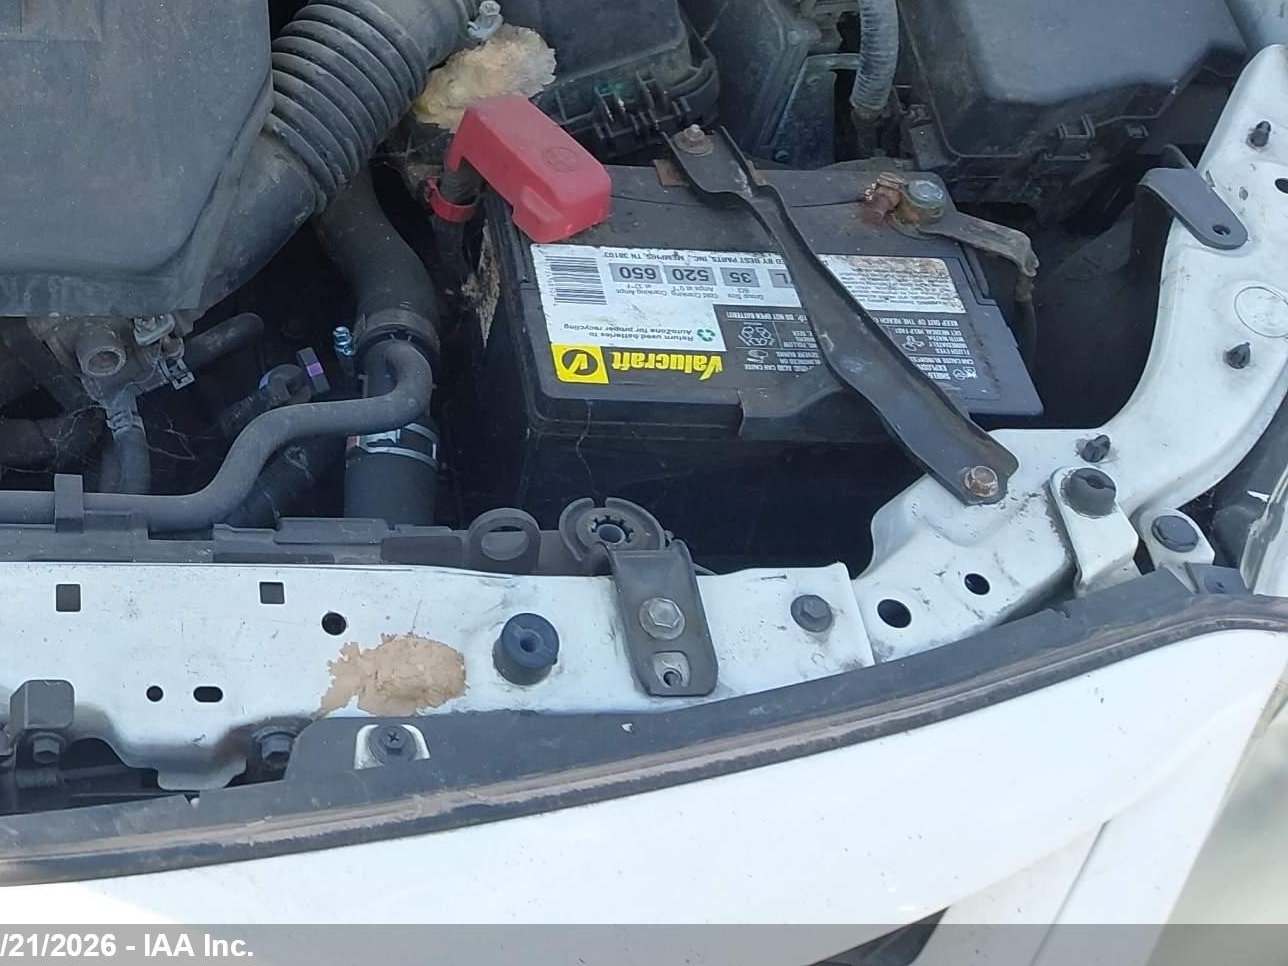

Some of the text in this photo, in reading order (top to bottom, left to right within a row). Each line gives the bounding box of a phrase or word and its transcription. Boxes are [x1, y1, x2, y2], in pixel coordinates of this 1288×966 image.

[619, 266, 656, 280] 650
[672, 268, 708, 282] 520
[730, 272, 752, 283] 35
[671, 290, 701, 298] Cranking
[564, 324, 602, 332] recycling
[611, 351, 723, 380] Valucraft
